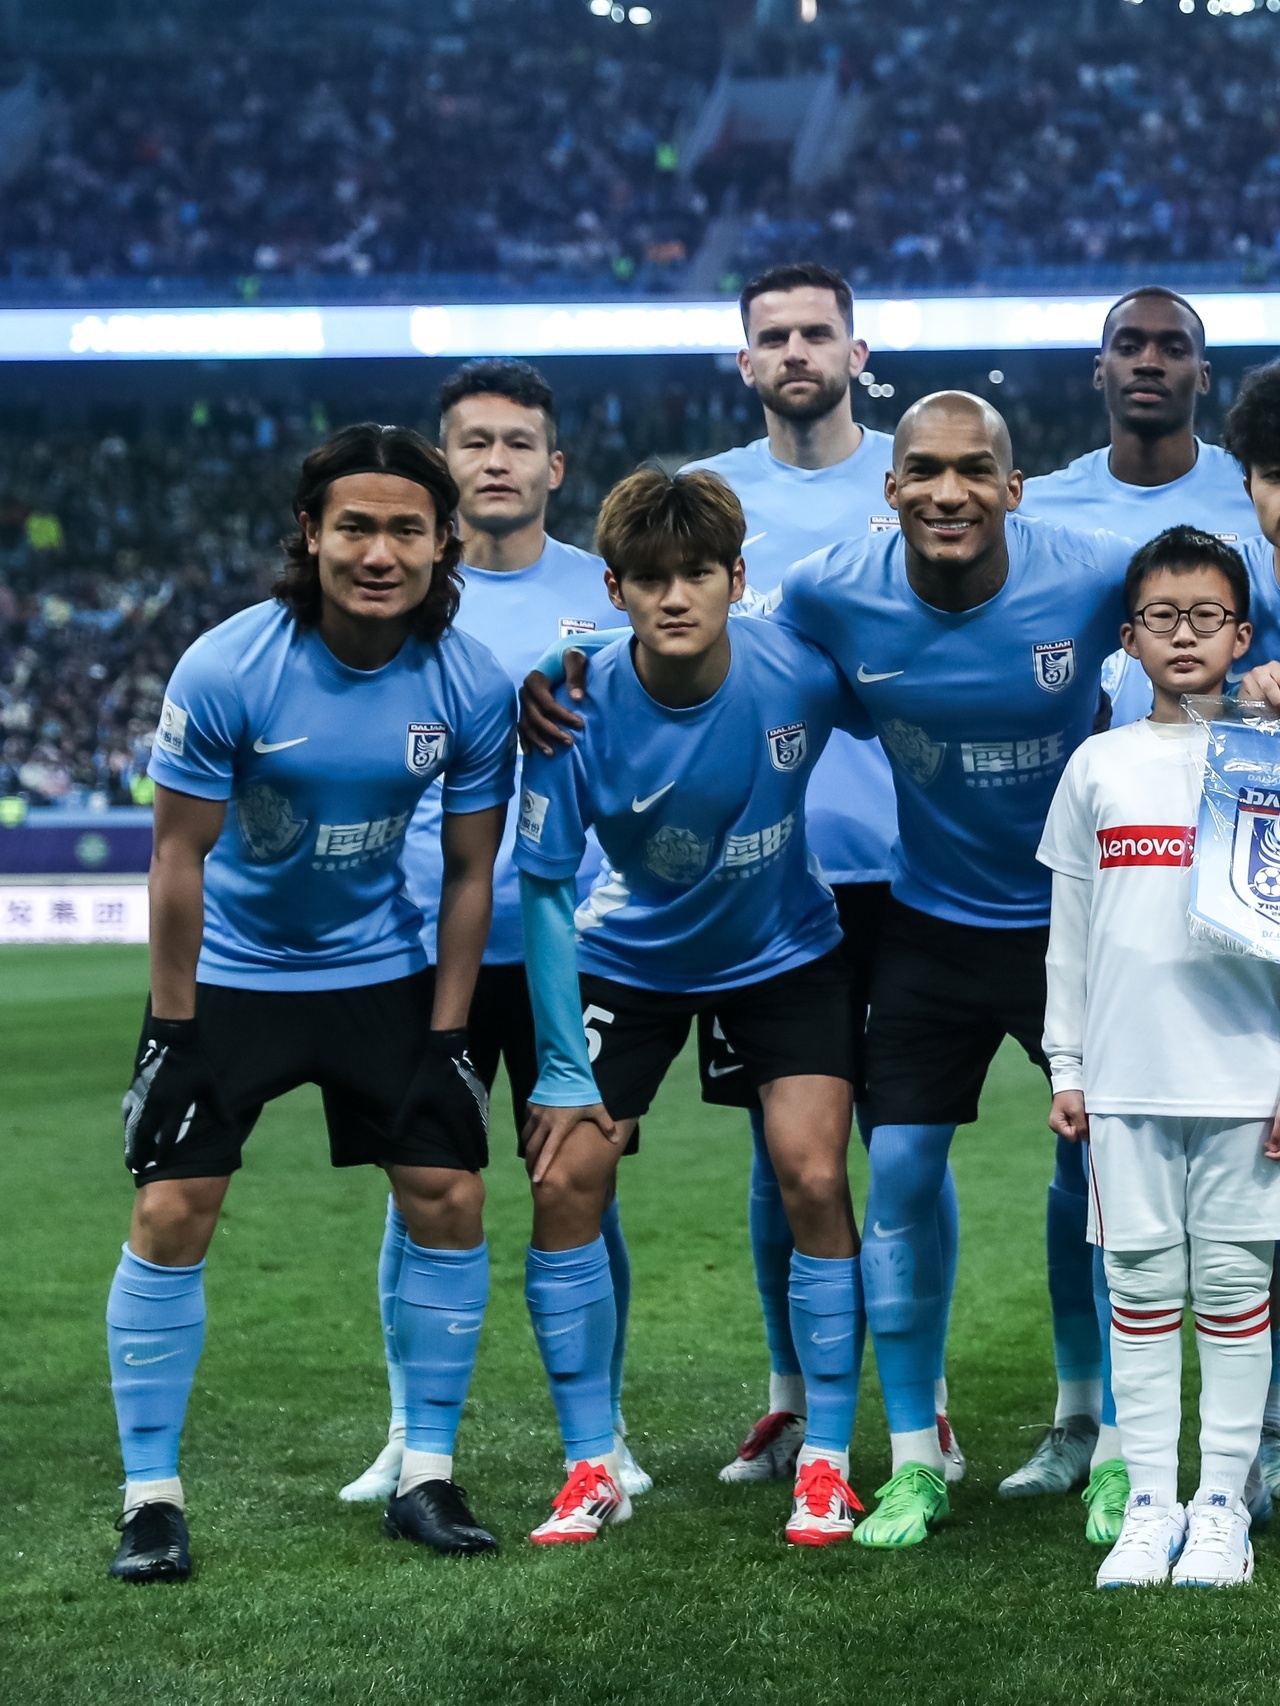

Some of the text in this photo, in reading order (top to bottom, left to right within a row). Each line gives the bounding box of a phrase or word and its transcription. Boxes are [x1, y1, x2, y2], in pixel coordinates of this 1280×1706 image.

[1036, 640, 1071, 650] DALIAN
[770, 722, 804, 736] DALIAN
[1103, 838, 1186, 859] Lenovo
